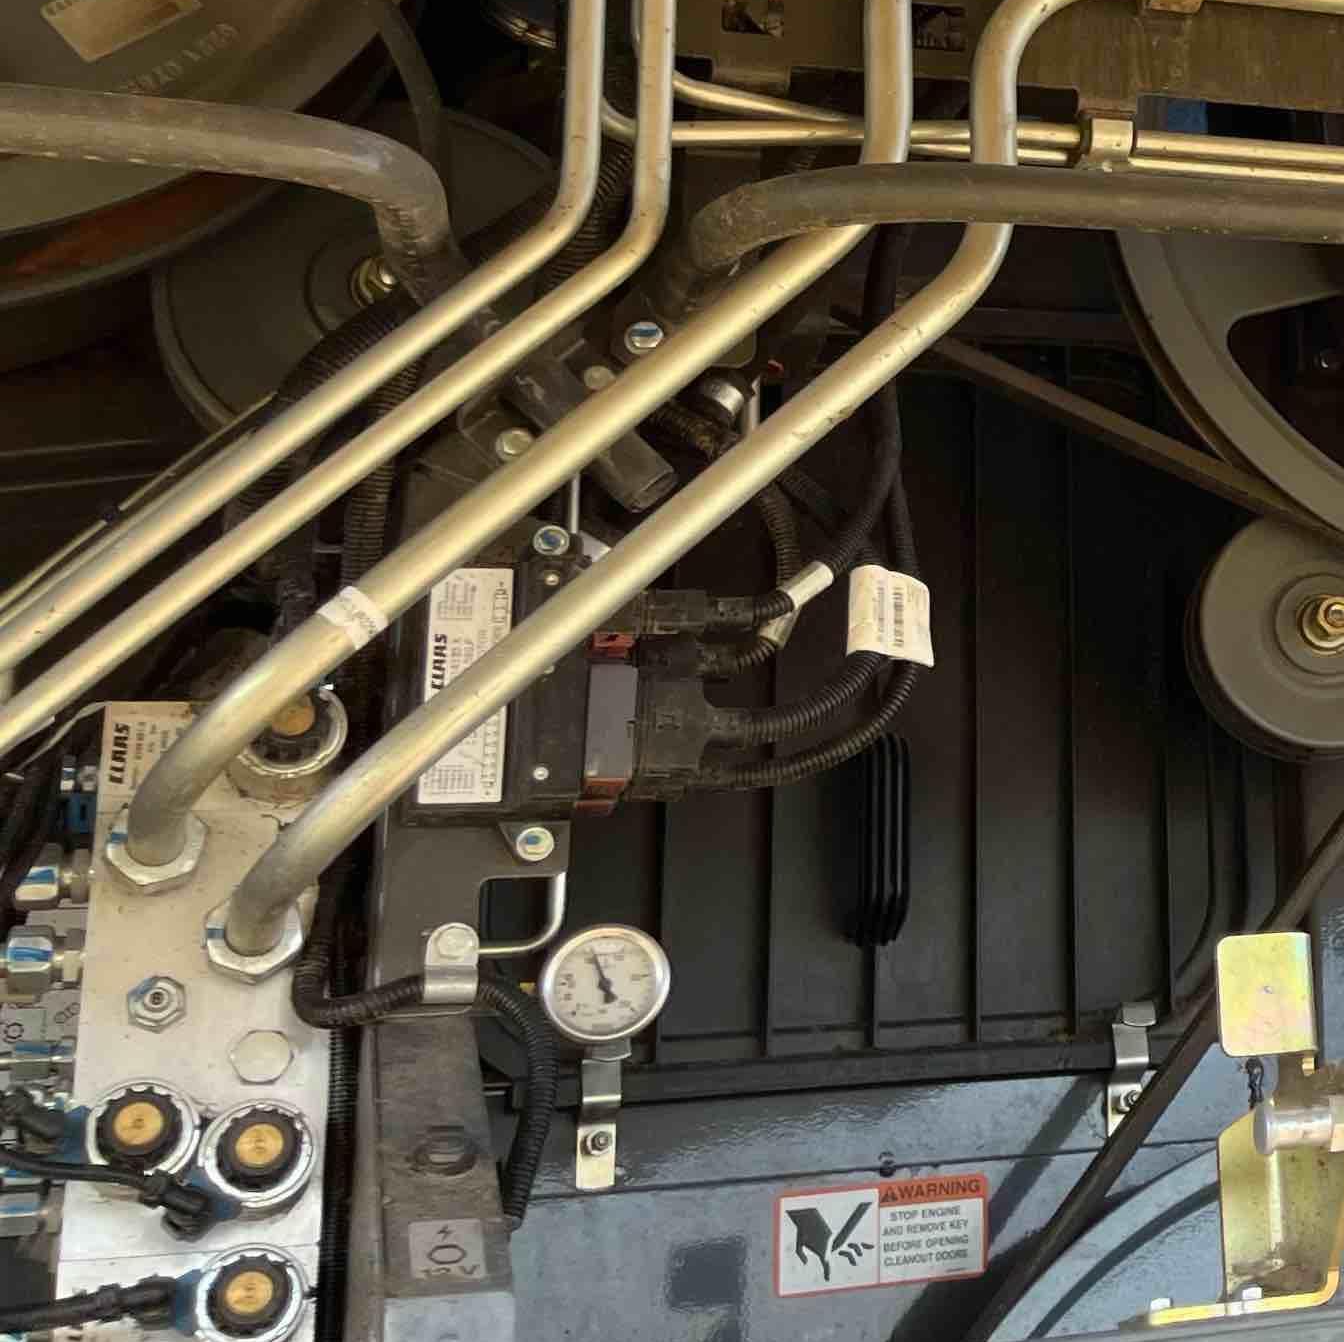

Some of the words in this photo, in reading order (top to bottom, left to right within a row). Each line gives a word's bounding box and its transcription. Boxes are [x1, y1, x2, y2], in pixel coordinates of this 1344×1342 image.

[431, 634, 448, 690] CLAAS
[110, 723, 129, 785] CLAAS
[898, 1180, 979, 1198] WARNING
[889, 1210, 918, 1221] STOP
[922, 1206, 960, 1218] ENGINE
[882, 1226, 903, 1236] AND
[907, 1221, 945, 1234] REMOVE
[950, 1219, 968, 1229] KEY
[883, 1240, 921, 1252] BEFORE
[926, 1234, 968, 1248] OPENING
[884, 1253, 933, 1266] CLEANOUT
[936, 1250, 968, 1261] DOORS
